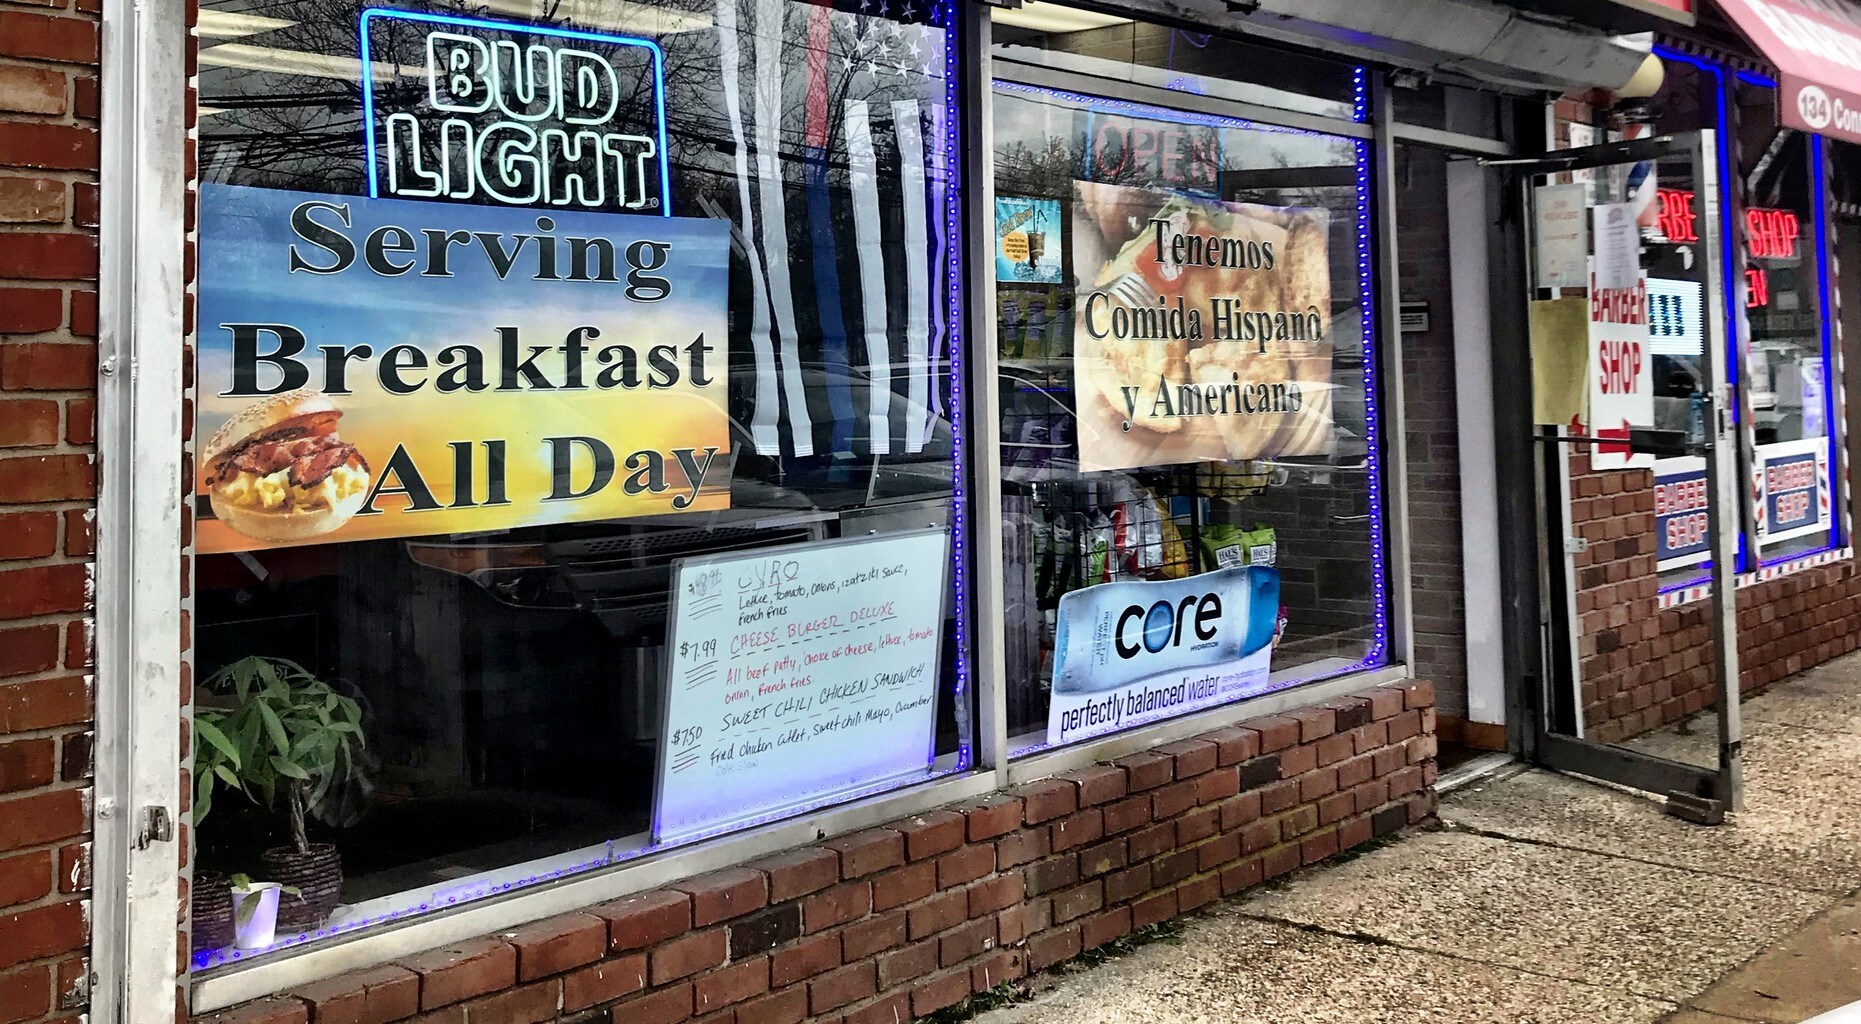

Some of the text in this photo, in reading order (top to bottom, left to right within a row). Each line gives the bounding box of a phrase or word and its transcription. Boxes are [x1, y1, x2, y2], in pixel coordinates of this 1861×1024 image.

[427, 31, 620, 126] BUD
[1801, 92, 1828, 123] 134
[387, 112, 656, 208] LIGHT
[1095, 121, 1218, 183] OPEN
[289, 200, 672, 303] Serving
[1149, 217, 1275, 271] Tenemos
[1746, 209, 1799, 259] SHOP
[1084, 290, 1204, 342] Comida
[1591, 271, 1646, 325] BARBER
[218, 322, 715, 399] Breakfast
[1600, 340, 1641, 395] SHOP
[1119, 370, 1303, 434] y Americano
[359, 435, 720, 515] All Day
[1654, 477, 1708, 517] BARBE
[1775, 490, 1810, 525] SHOP
[679, 601, 895, 662] $7.99 CHEESE BURGER DELUXE
[1115, 592, 1222, 659] core
[721, 703, 773, 732] SWEET
[775, 696, 813, 718] CHILI
[820, 677, 869, 705] CHICKEN
[871, 662, 926, 691] SANDWICH
[1060, 674, 1221, 739] perfectly balanced water
